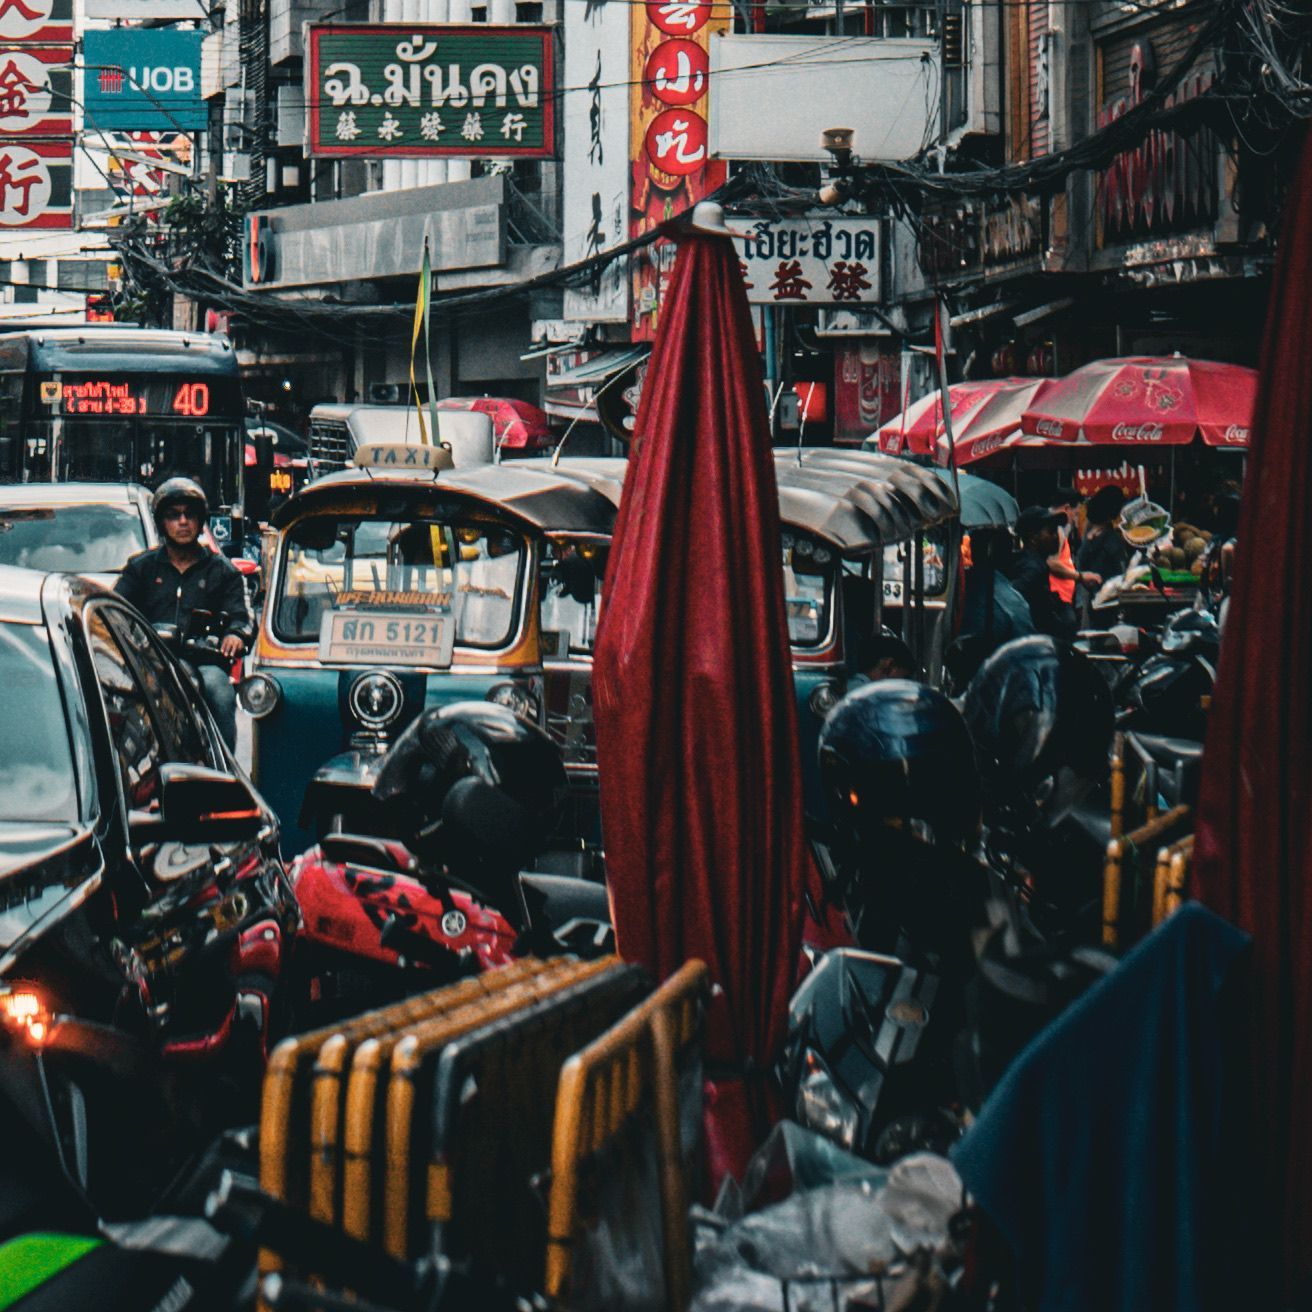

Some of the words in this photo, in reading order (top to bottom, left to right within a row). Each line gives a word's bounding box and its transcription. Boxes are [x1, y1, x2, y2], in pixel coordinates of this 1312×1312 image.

[129, 66, 195, 92] UOB
[323, 35, 539, 108] ฉ.มั่นคง
[738, 260, 874, 301] 益發
[173, 382, 209, 416] 40
[371, 447, 431, 466] TAXI
[385, 621, 440, 645] 5121
